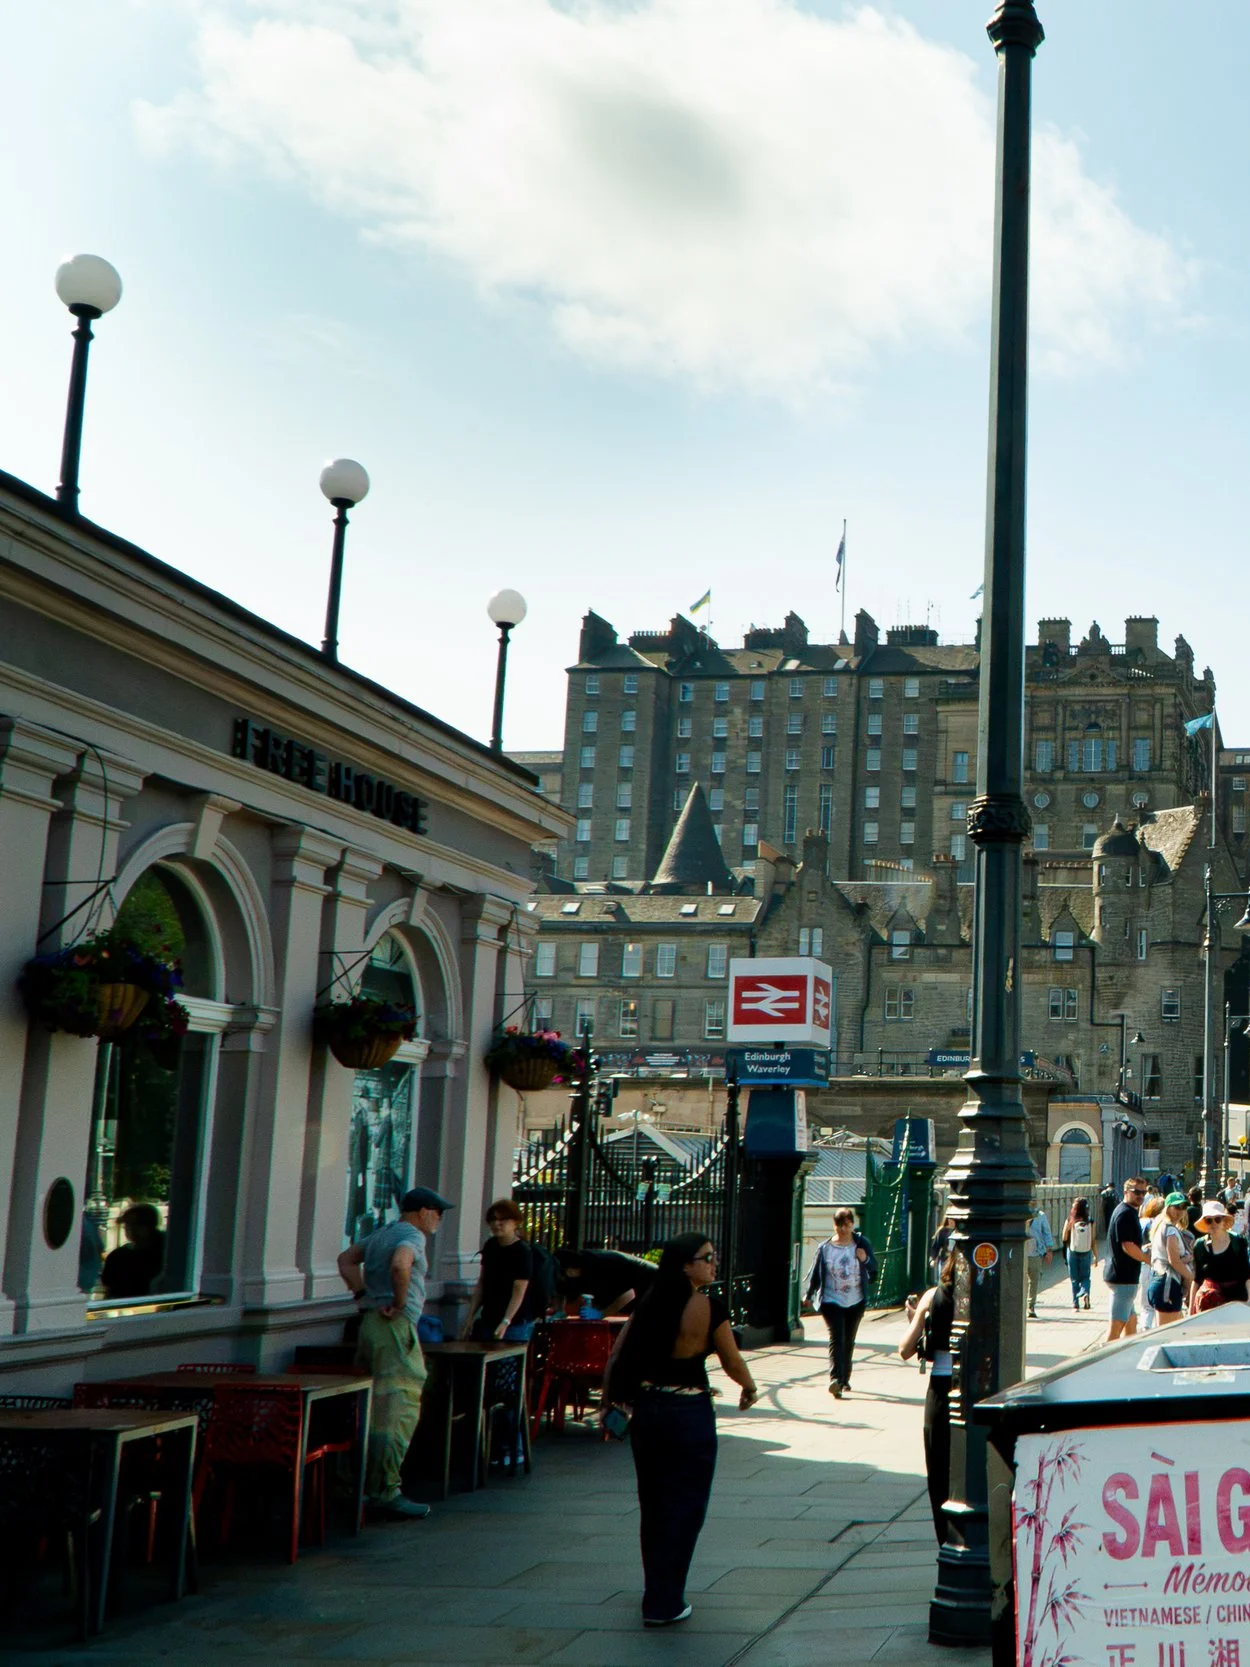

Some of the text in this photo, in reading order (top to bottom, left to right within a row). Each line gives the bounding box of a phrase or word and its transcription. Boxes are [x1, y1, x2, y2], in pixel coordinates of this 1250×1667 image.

[233, 718, 430, 836] FREE HOUSE
[744, 1051, 791, 1062] Edinburgh
[746, 1064, 791, 1075] Waverley
[1102, 1452, 1202, 1560] SÀI
[1103, 1605, 1201, 1627] VIETNAMESE
